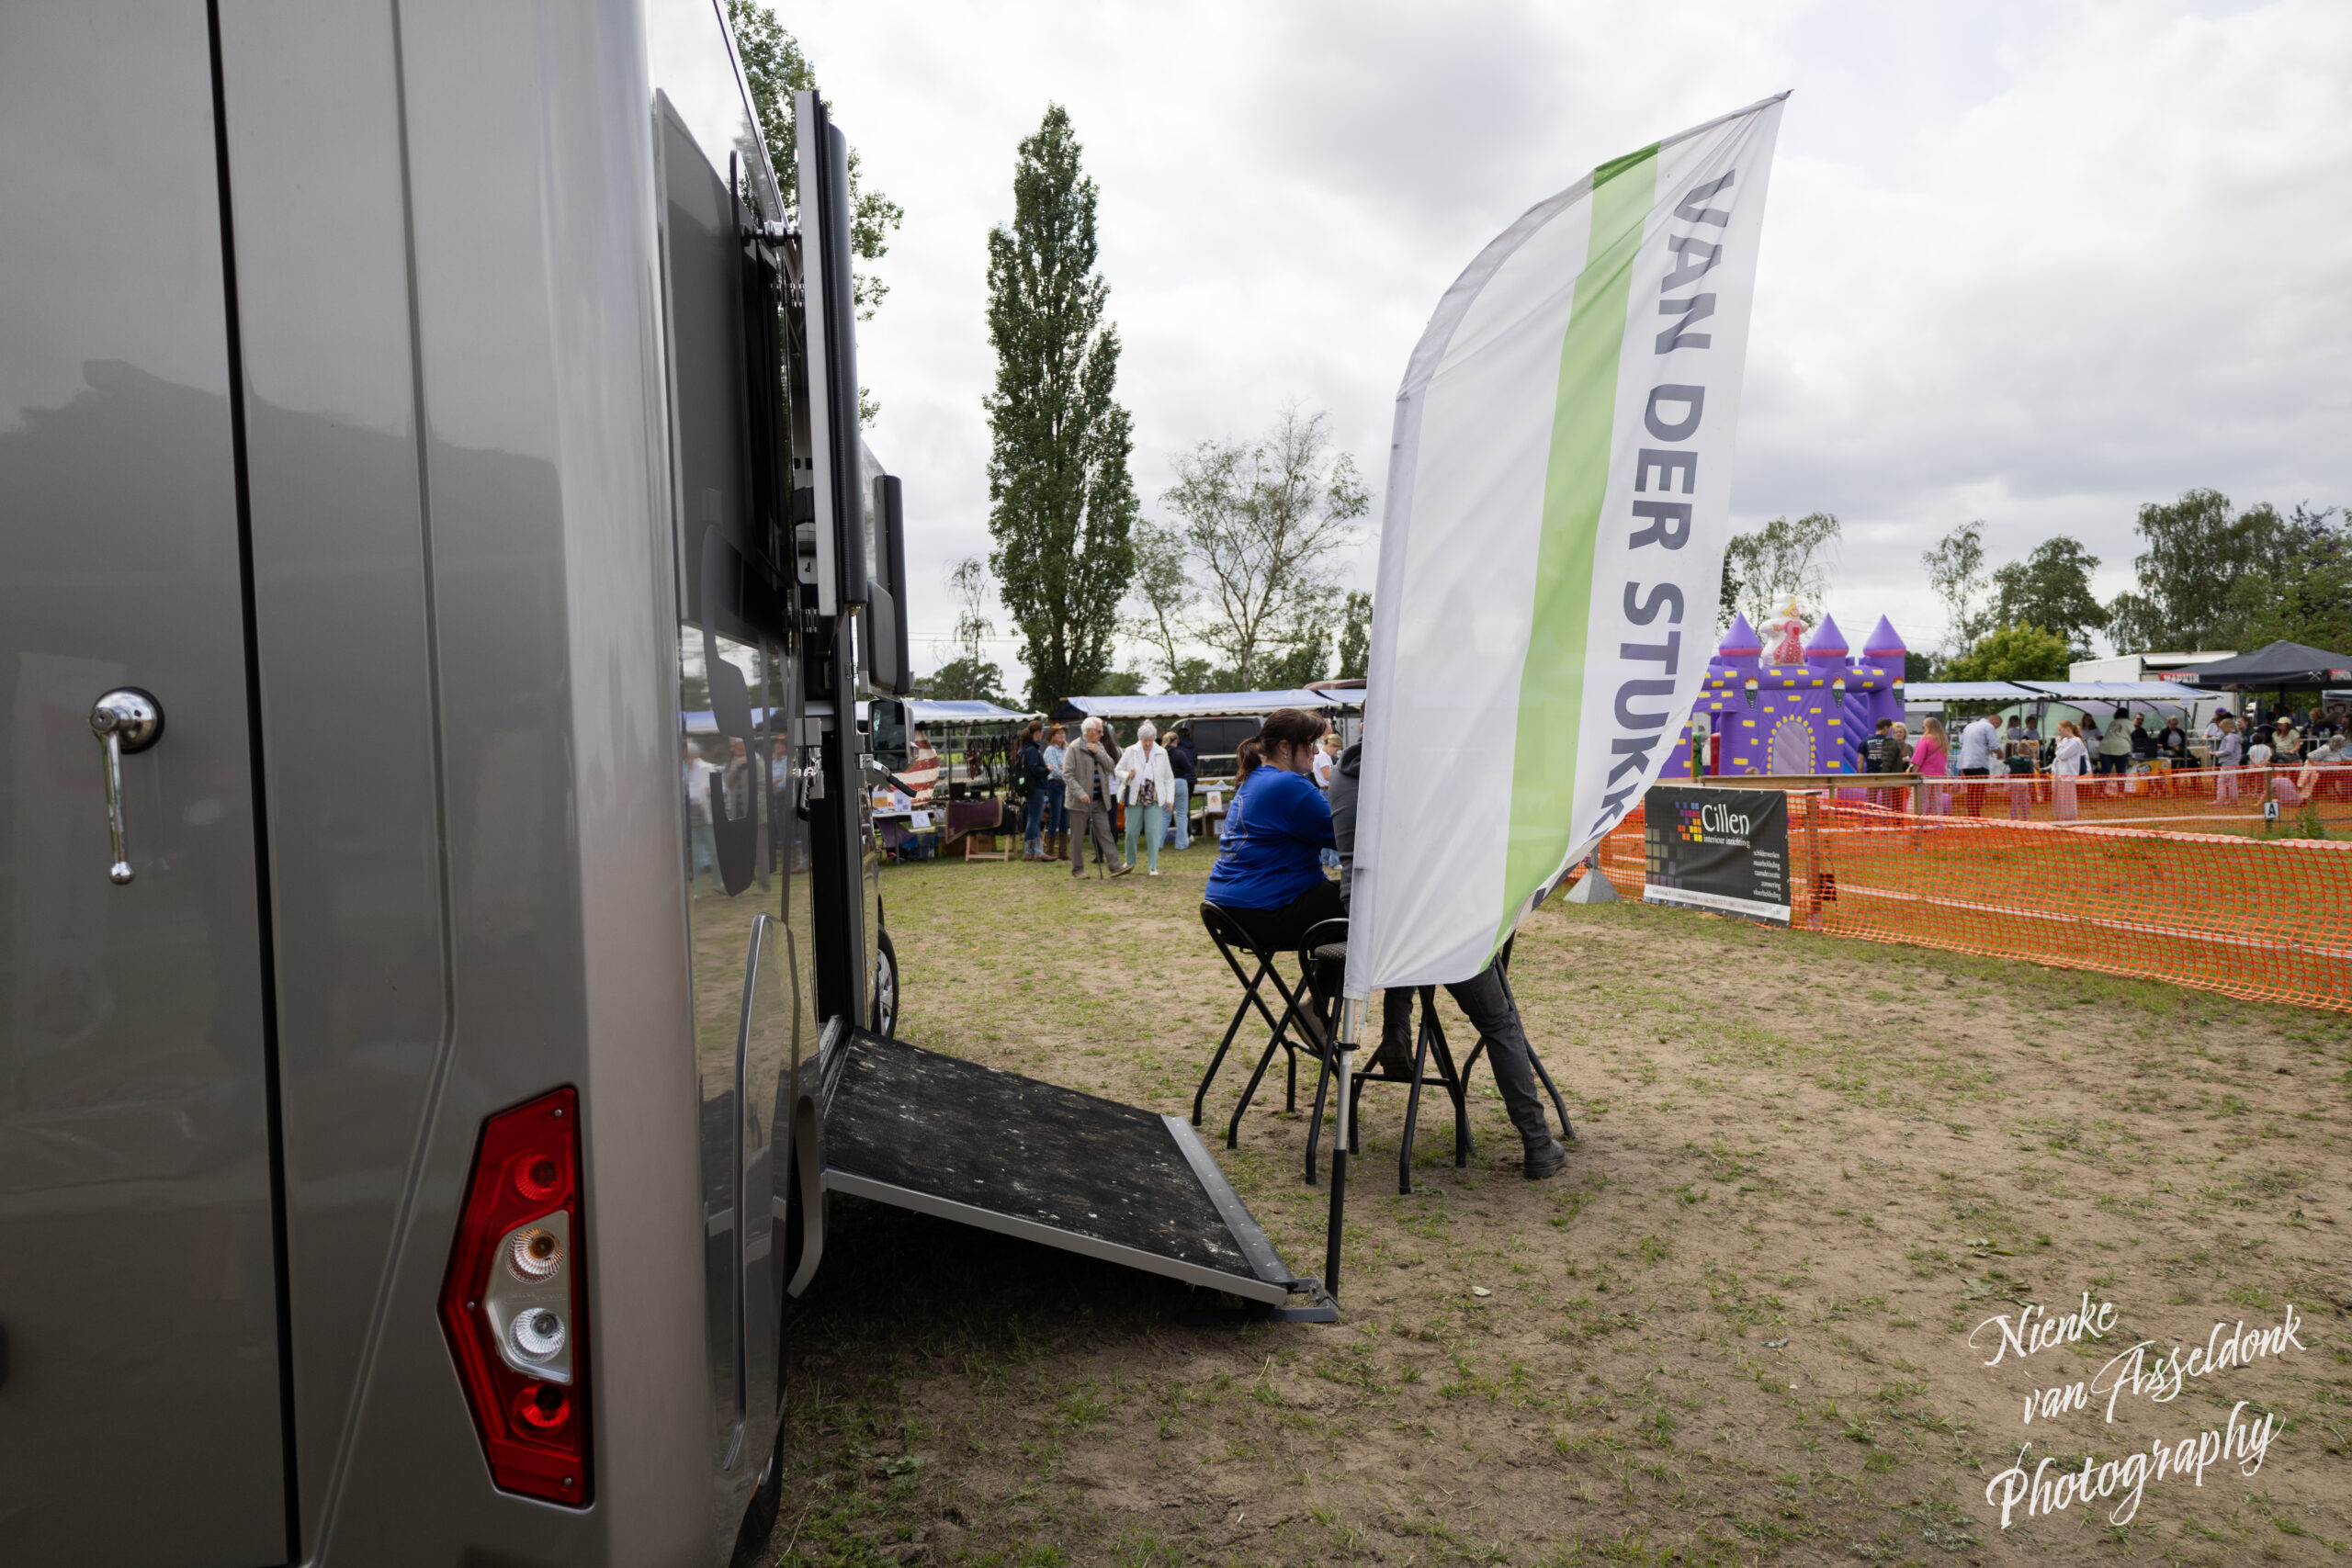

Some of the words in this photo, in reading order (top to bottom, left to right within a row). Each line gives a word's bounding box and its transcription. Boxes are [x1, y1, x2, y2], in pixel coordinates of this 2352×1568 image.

[1654, 169, 1736, 355] VAN
[1629, 384, 1706, 550] DER
[1586, 581, 1685, 841] STUKK
[1702, 804, 1749, 835] Cillen
[1703, 834, 1724, 844] interieur
[1726, 836, 1750, 849] inrichting
[2267, 803, 2278, 817] A
